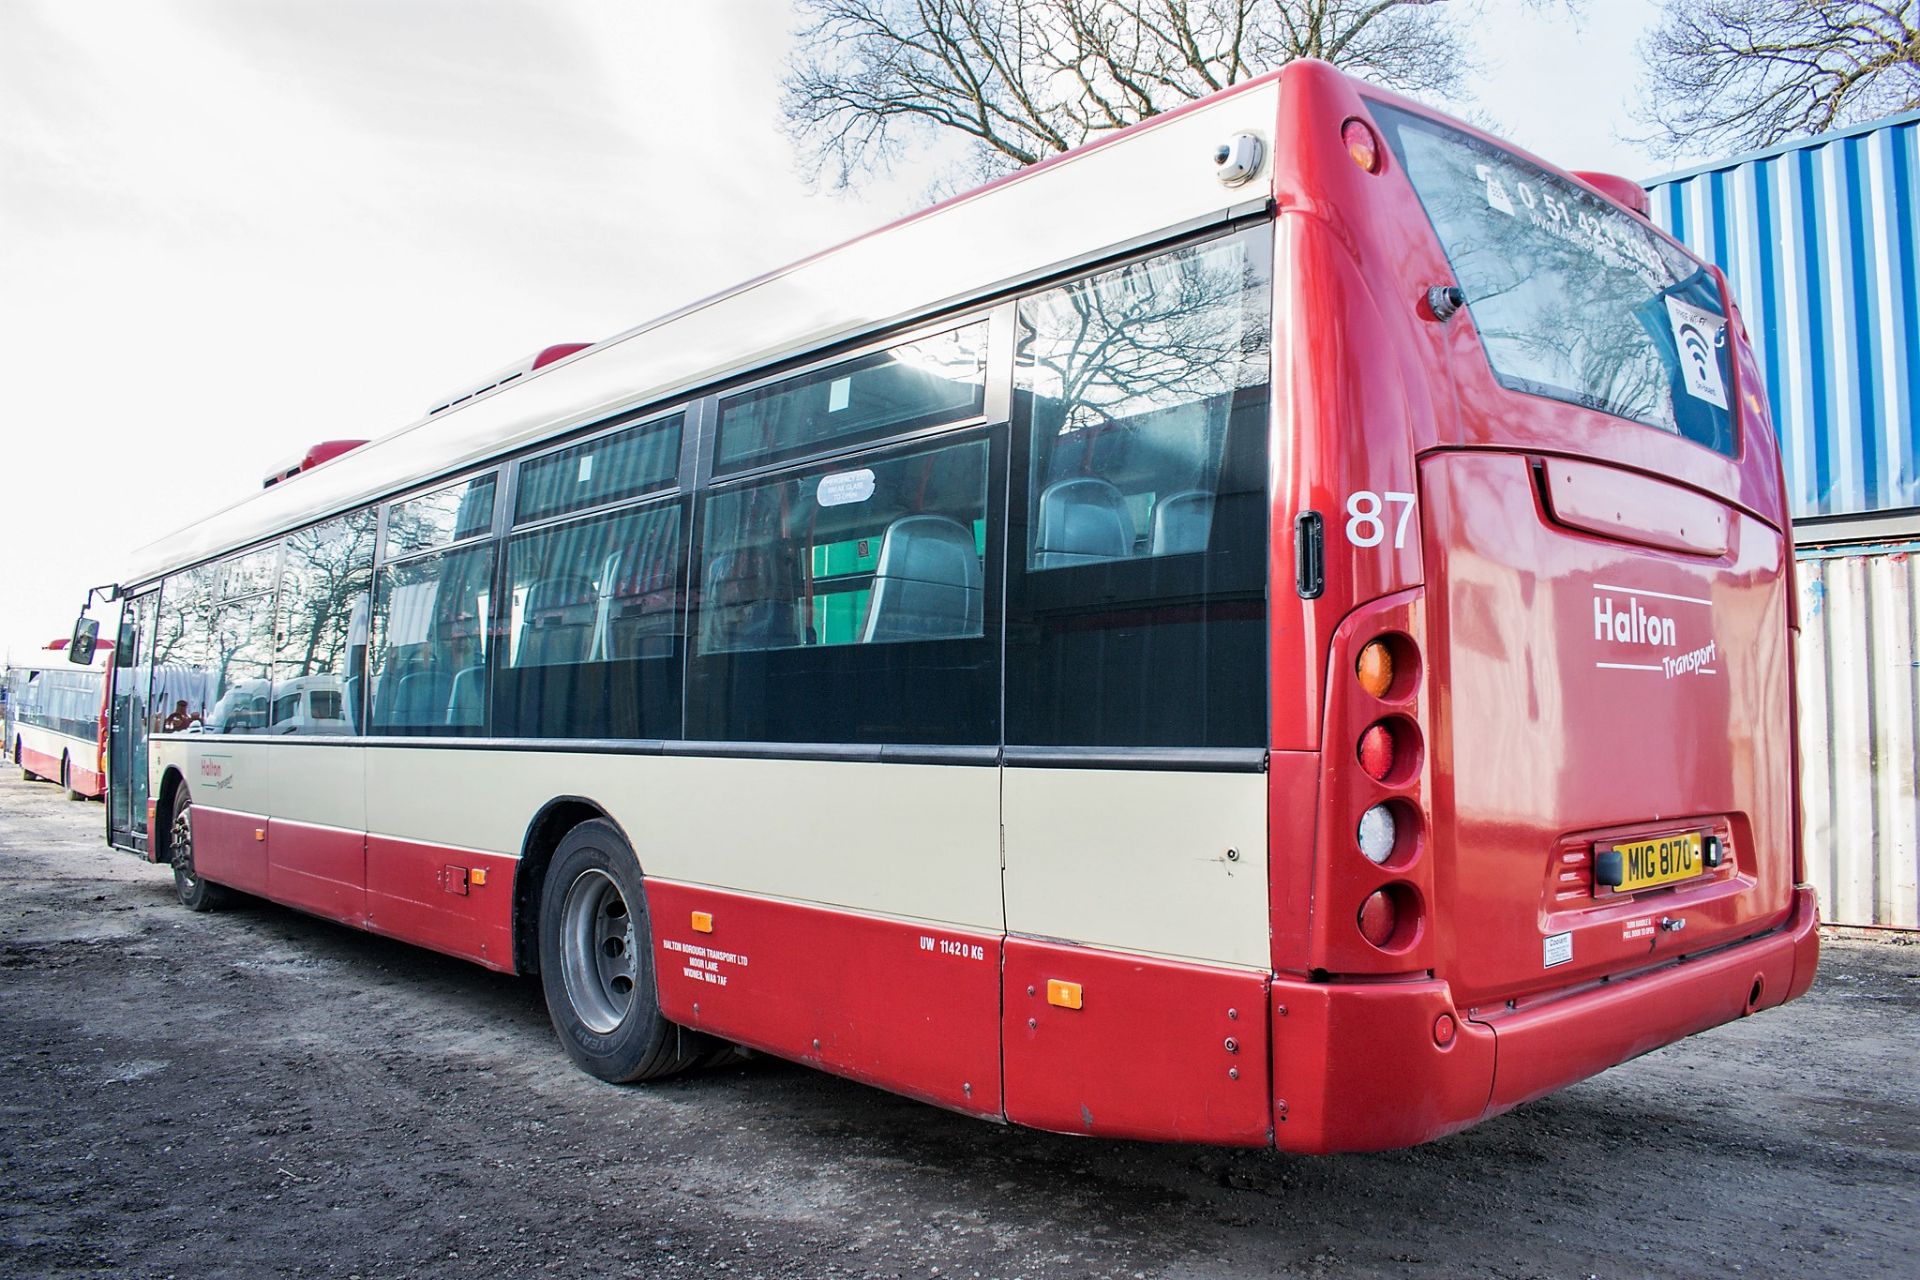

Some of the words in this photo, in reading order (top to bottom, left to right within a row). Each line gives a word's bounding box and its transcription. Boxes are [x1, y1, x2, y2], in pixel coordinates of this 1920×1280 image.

[1345, 490, 1416, 549] 87
[1593, 596, 1676, 646] Halton
[1662, 639, 1716, 679] Transport
[1628, 845, 1655, 881] MIG
[1660, 838, 1692, 875] 8170
[663, 939, 682, 951] HALTON
[682, 943, 706, 956] BOROUGH
[706, 948, 737, 963] TRANSPORT
[738, 955, 748, 966] LTD
[689, 956, 704, 969] MOOR
[705, 959, 719, 972] LANE
[920, 936, 935, 951] UW
[971, 944, 984, 961] KG
